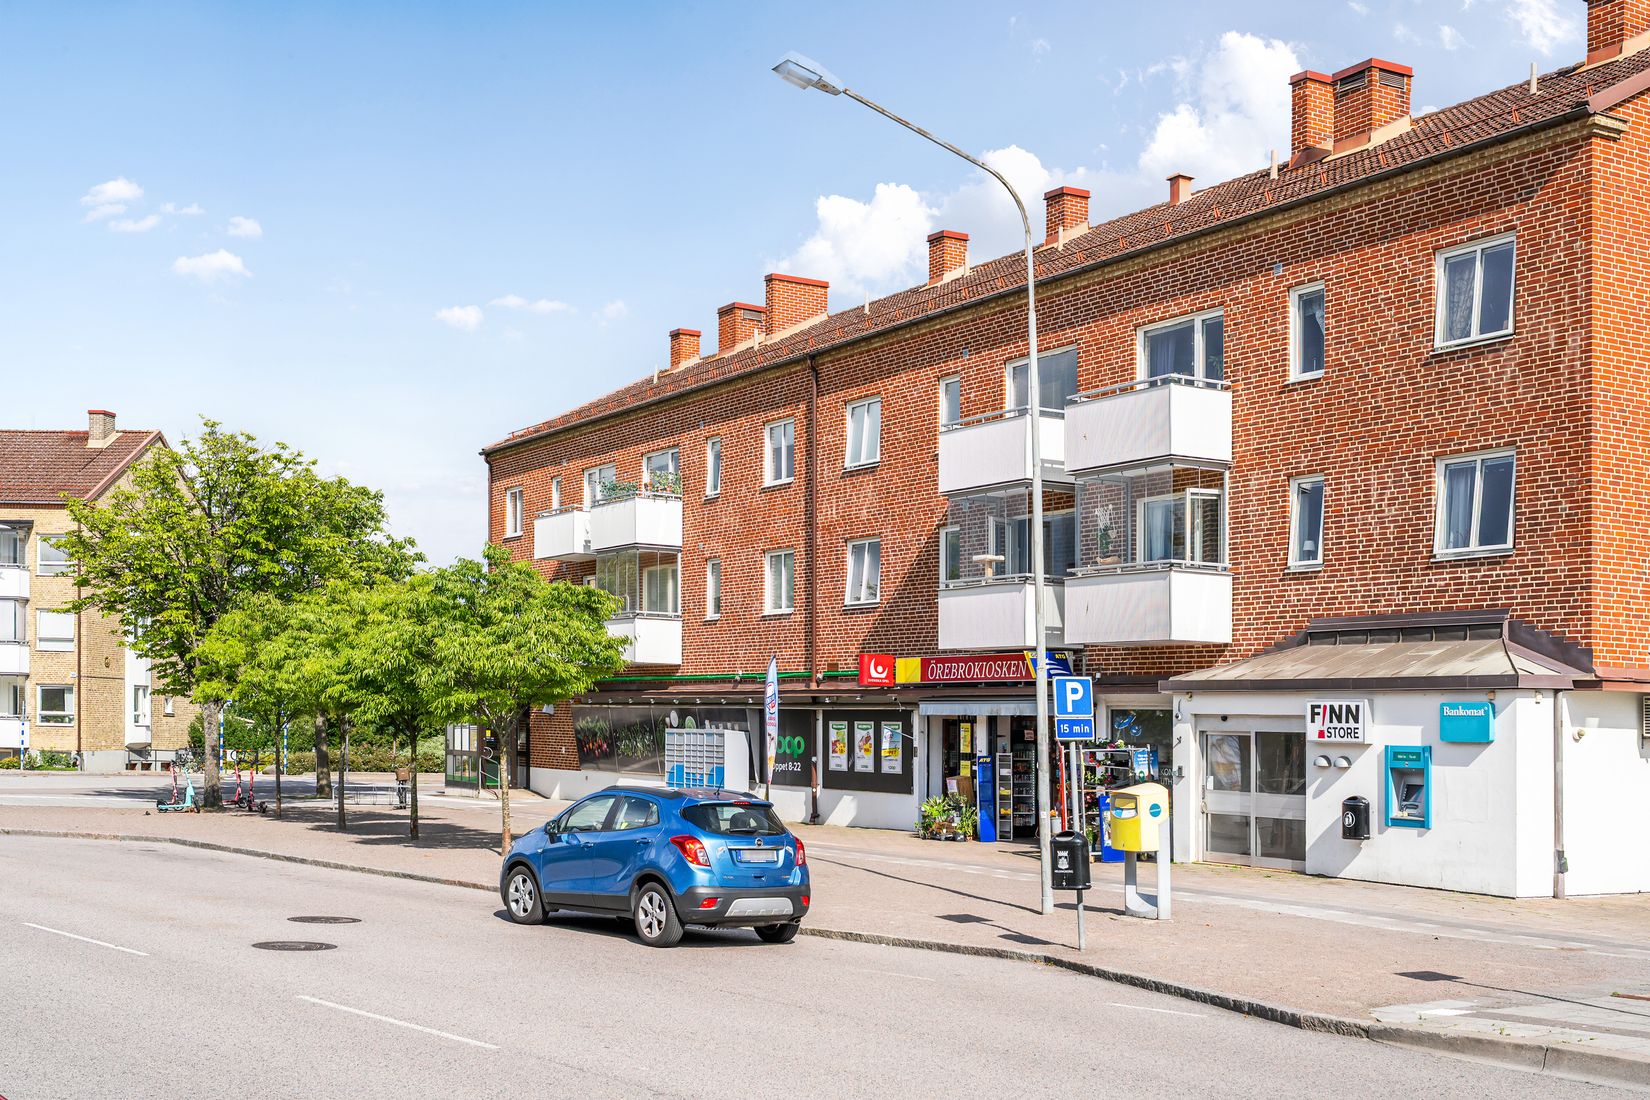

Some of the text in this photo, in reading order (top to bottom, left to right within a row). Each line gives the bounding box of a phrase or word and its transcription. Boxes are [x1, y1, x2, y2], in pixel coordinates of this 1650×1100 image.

[928, 660, 1027, 679] ÖREBROKIOSKEN
[1066, 682, 1084, 712] P
[1443, 706, 1485, 716] Bankomat
[1061, 724, 1090, 733] 15 min
[1326, 727, 1360, 739] STORE
[776, 735, 805, 758] oop
[789, 762, 802, 771] 8-22
